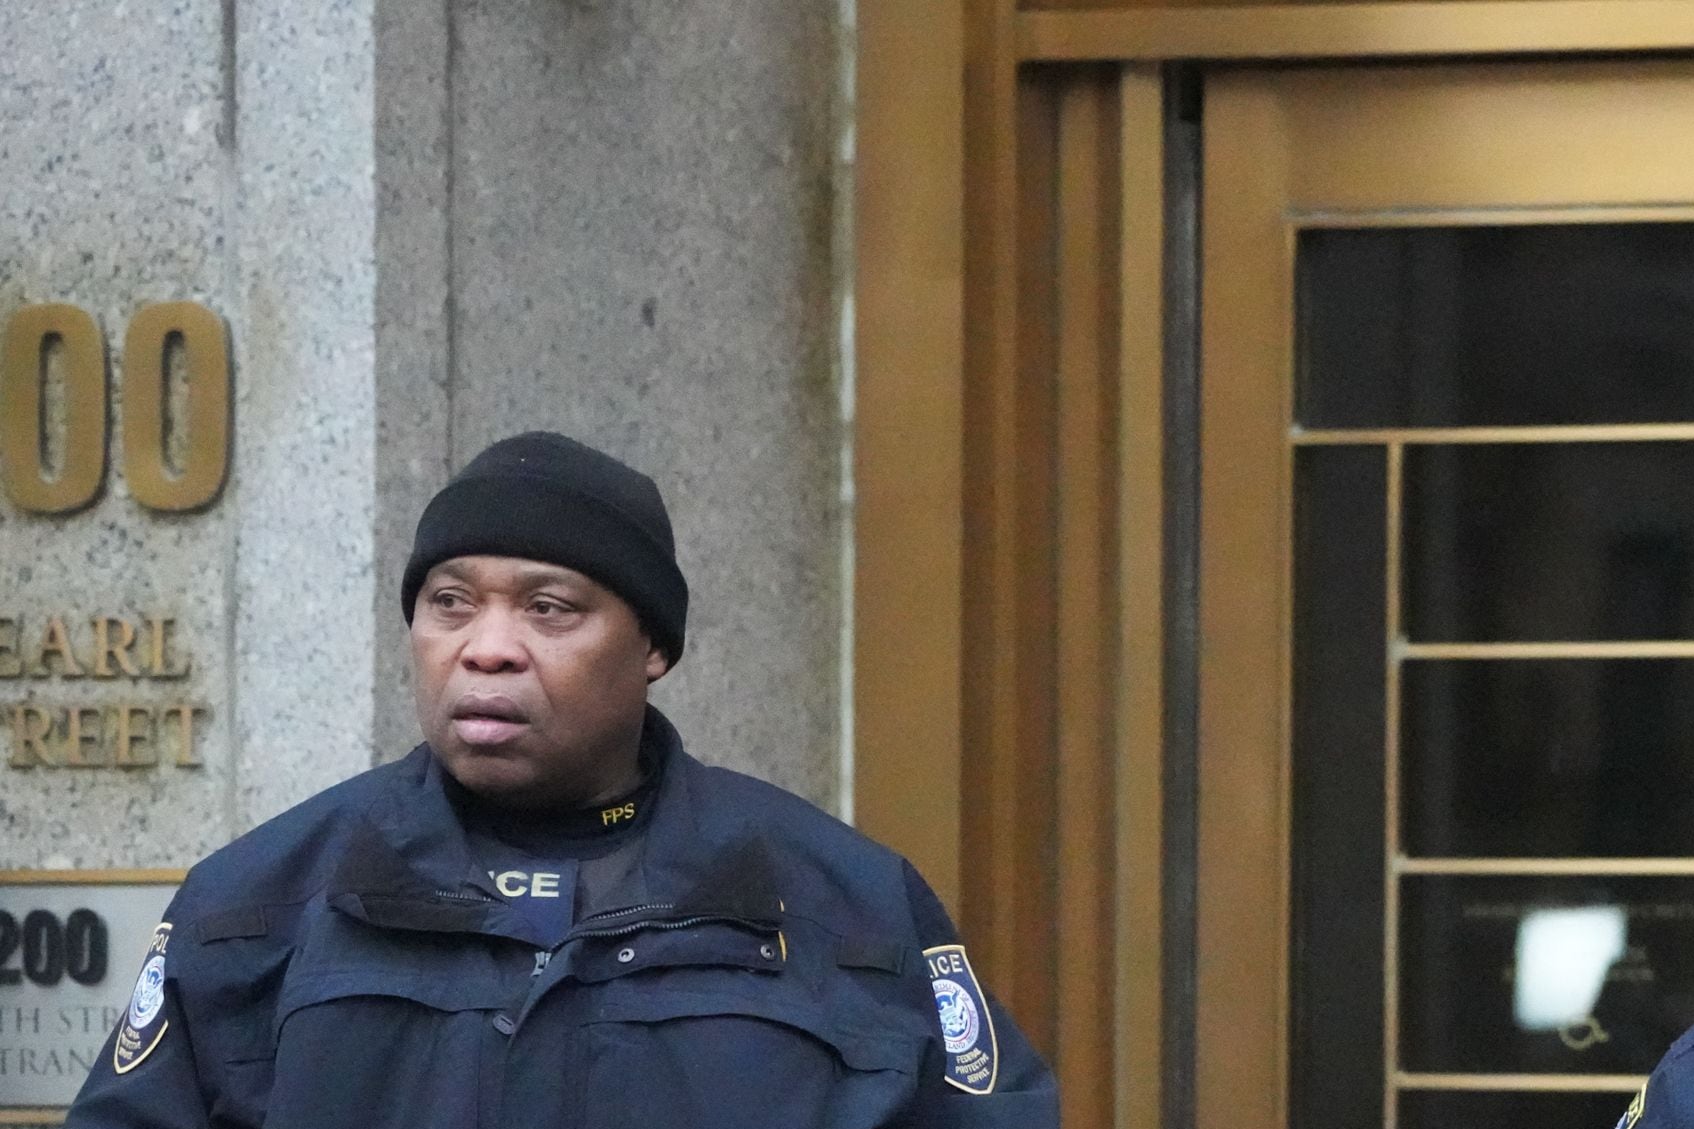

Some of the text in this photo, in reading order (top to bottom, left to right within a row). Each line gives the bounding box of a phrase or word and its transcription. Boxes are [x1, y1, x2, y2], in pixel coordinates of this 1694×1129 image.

[0, 706, 210, 769] REET
[602, 803, 635, 826] FPS
[488, 871, 560, 897] CE
[928, 954, 963, 978] ICE
